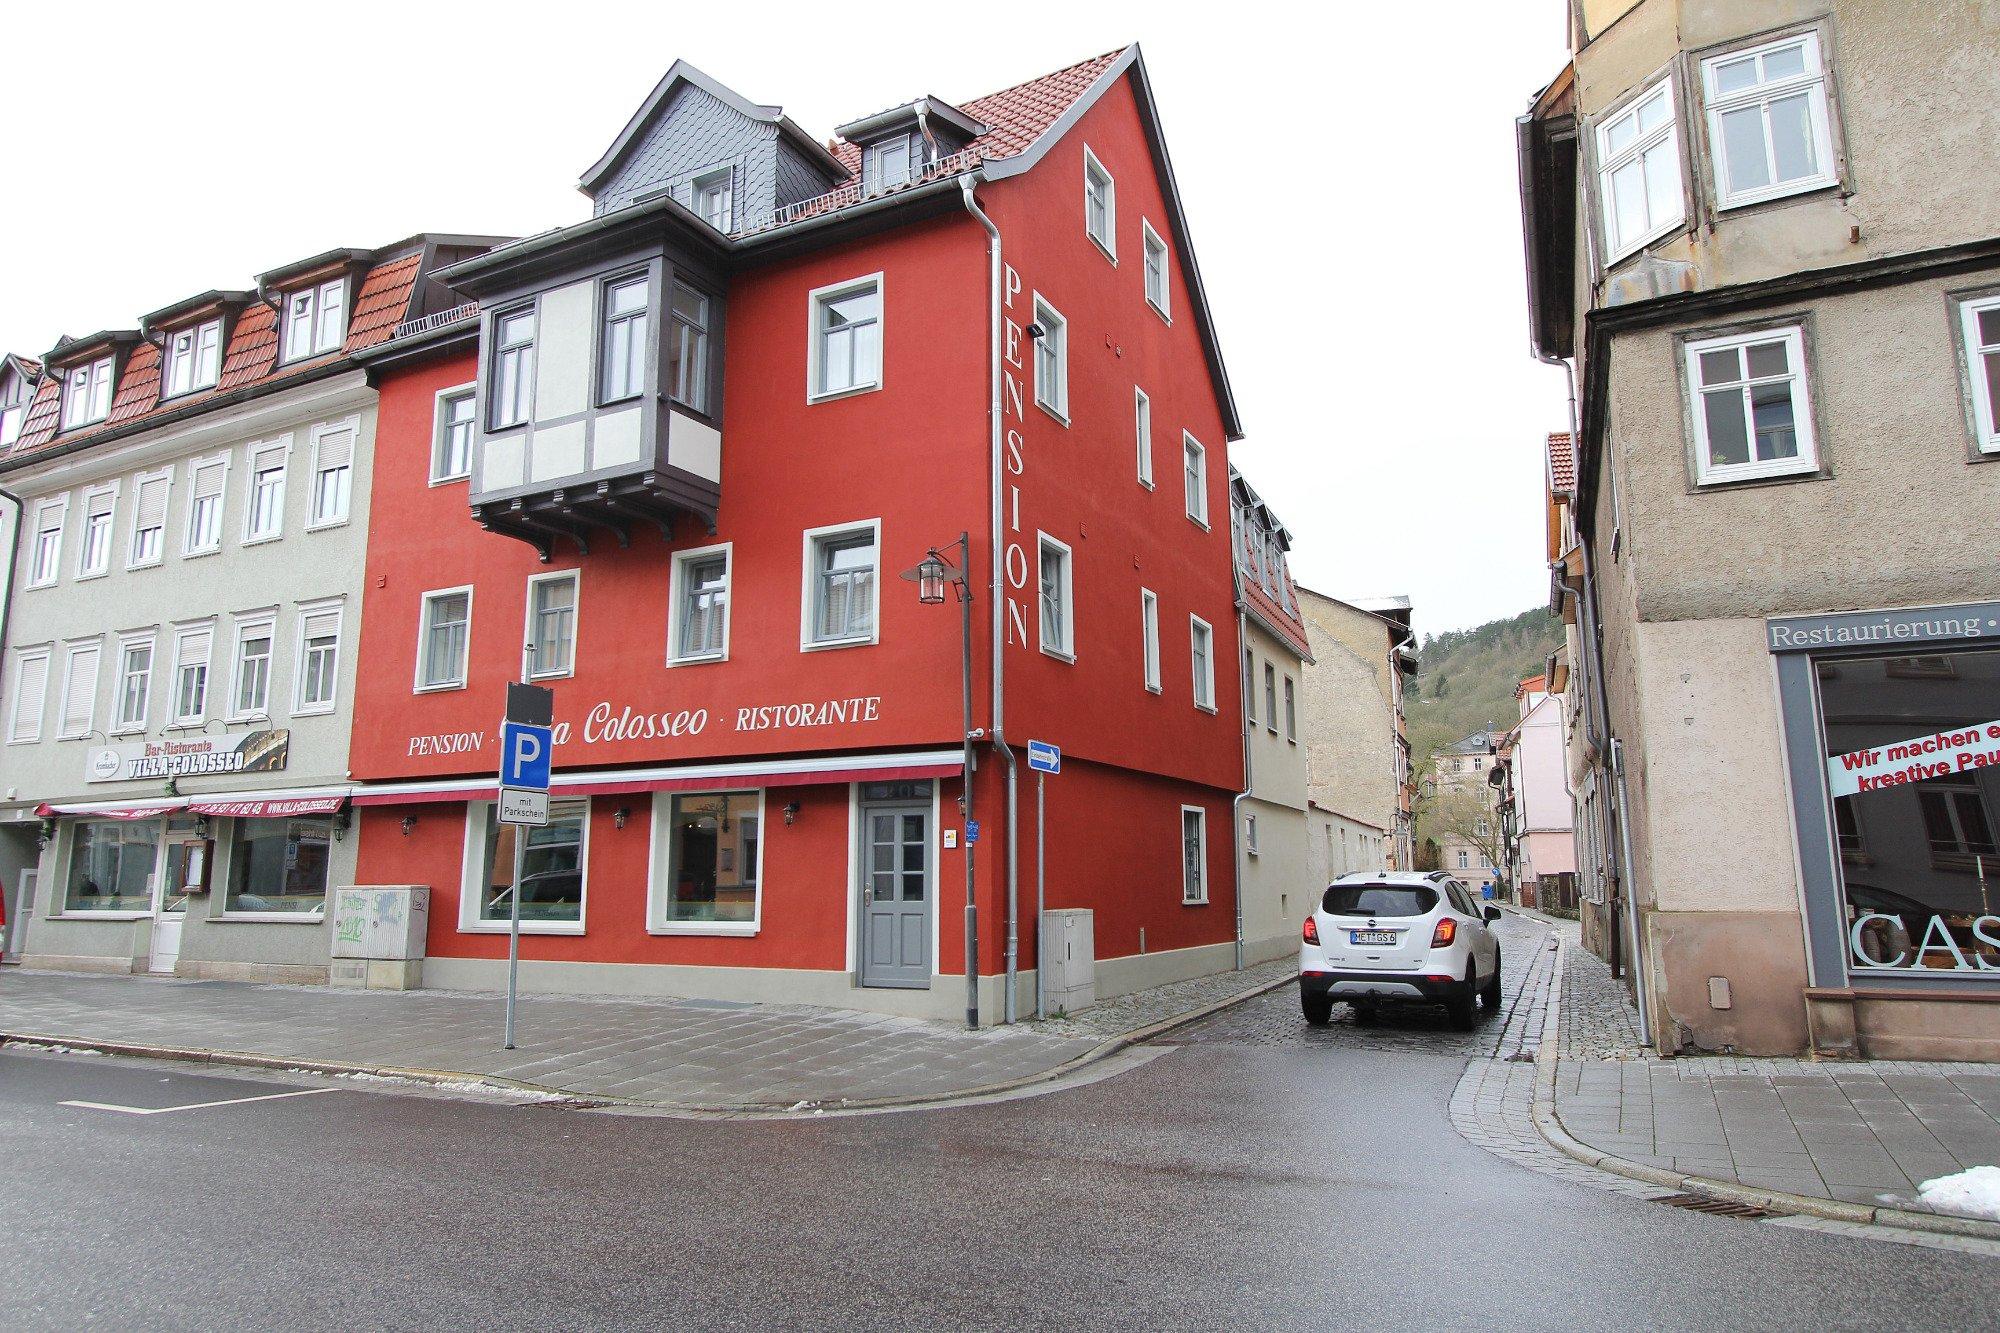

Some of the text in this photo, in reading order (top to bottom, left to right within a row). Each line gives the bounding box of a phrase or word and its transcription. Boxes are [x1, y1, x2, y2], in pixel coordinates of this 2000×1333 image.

[1003, 261, 1028, 650] PENSION
[1770, 618, 1981, 648] Restaurierung
[407, 731, 485, 757] PENSION
[583, 701, 708, 743] Colosseo
[735, 696, 881, 731] RISTORANTE
[127, 751, 245, 779] VILLA-COLOSSEO
[513, 732, 541, 779] P
[1840, 748, 1881, 771] Wir
[1887, 728, 1981, 762] machen
[1857, 761, 1951, 792] kreative
[504, 806, 545, 818] Parkschein
[519, 798, 532, 806] mit
